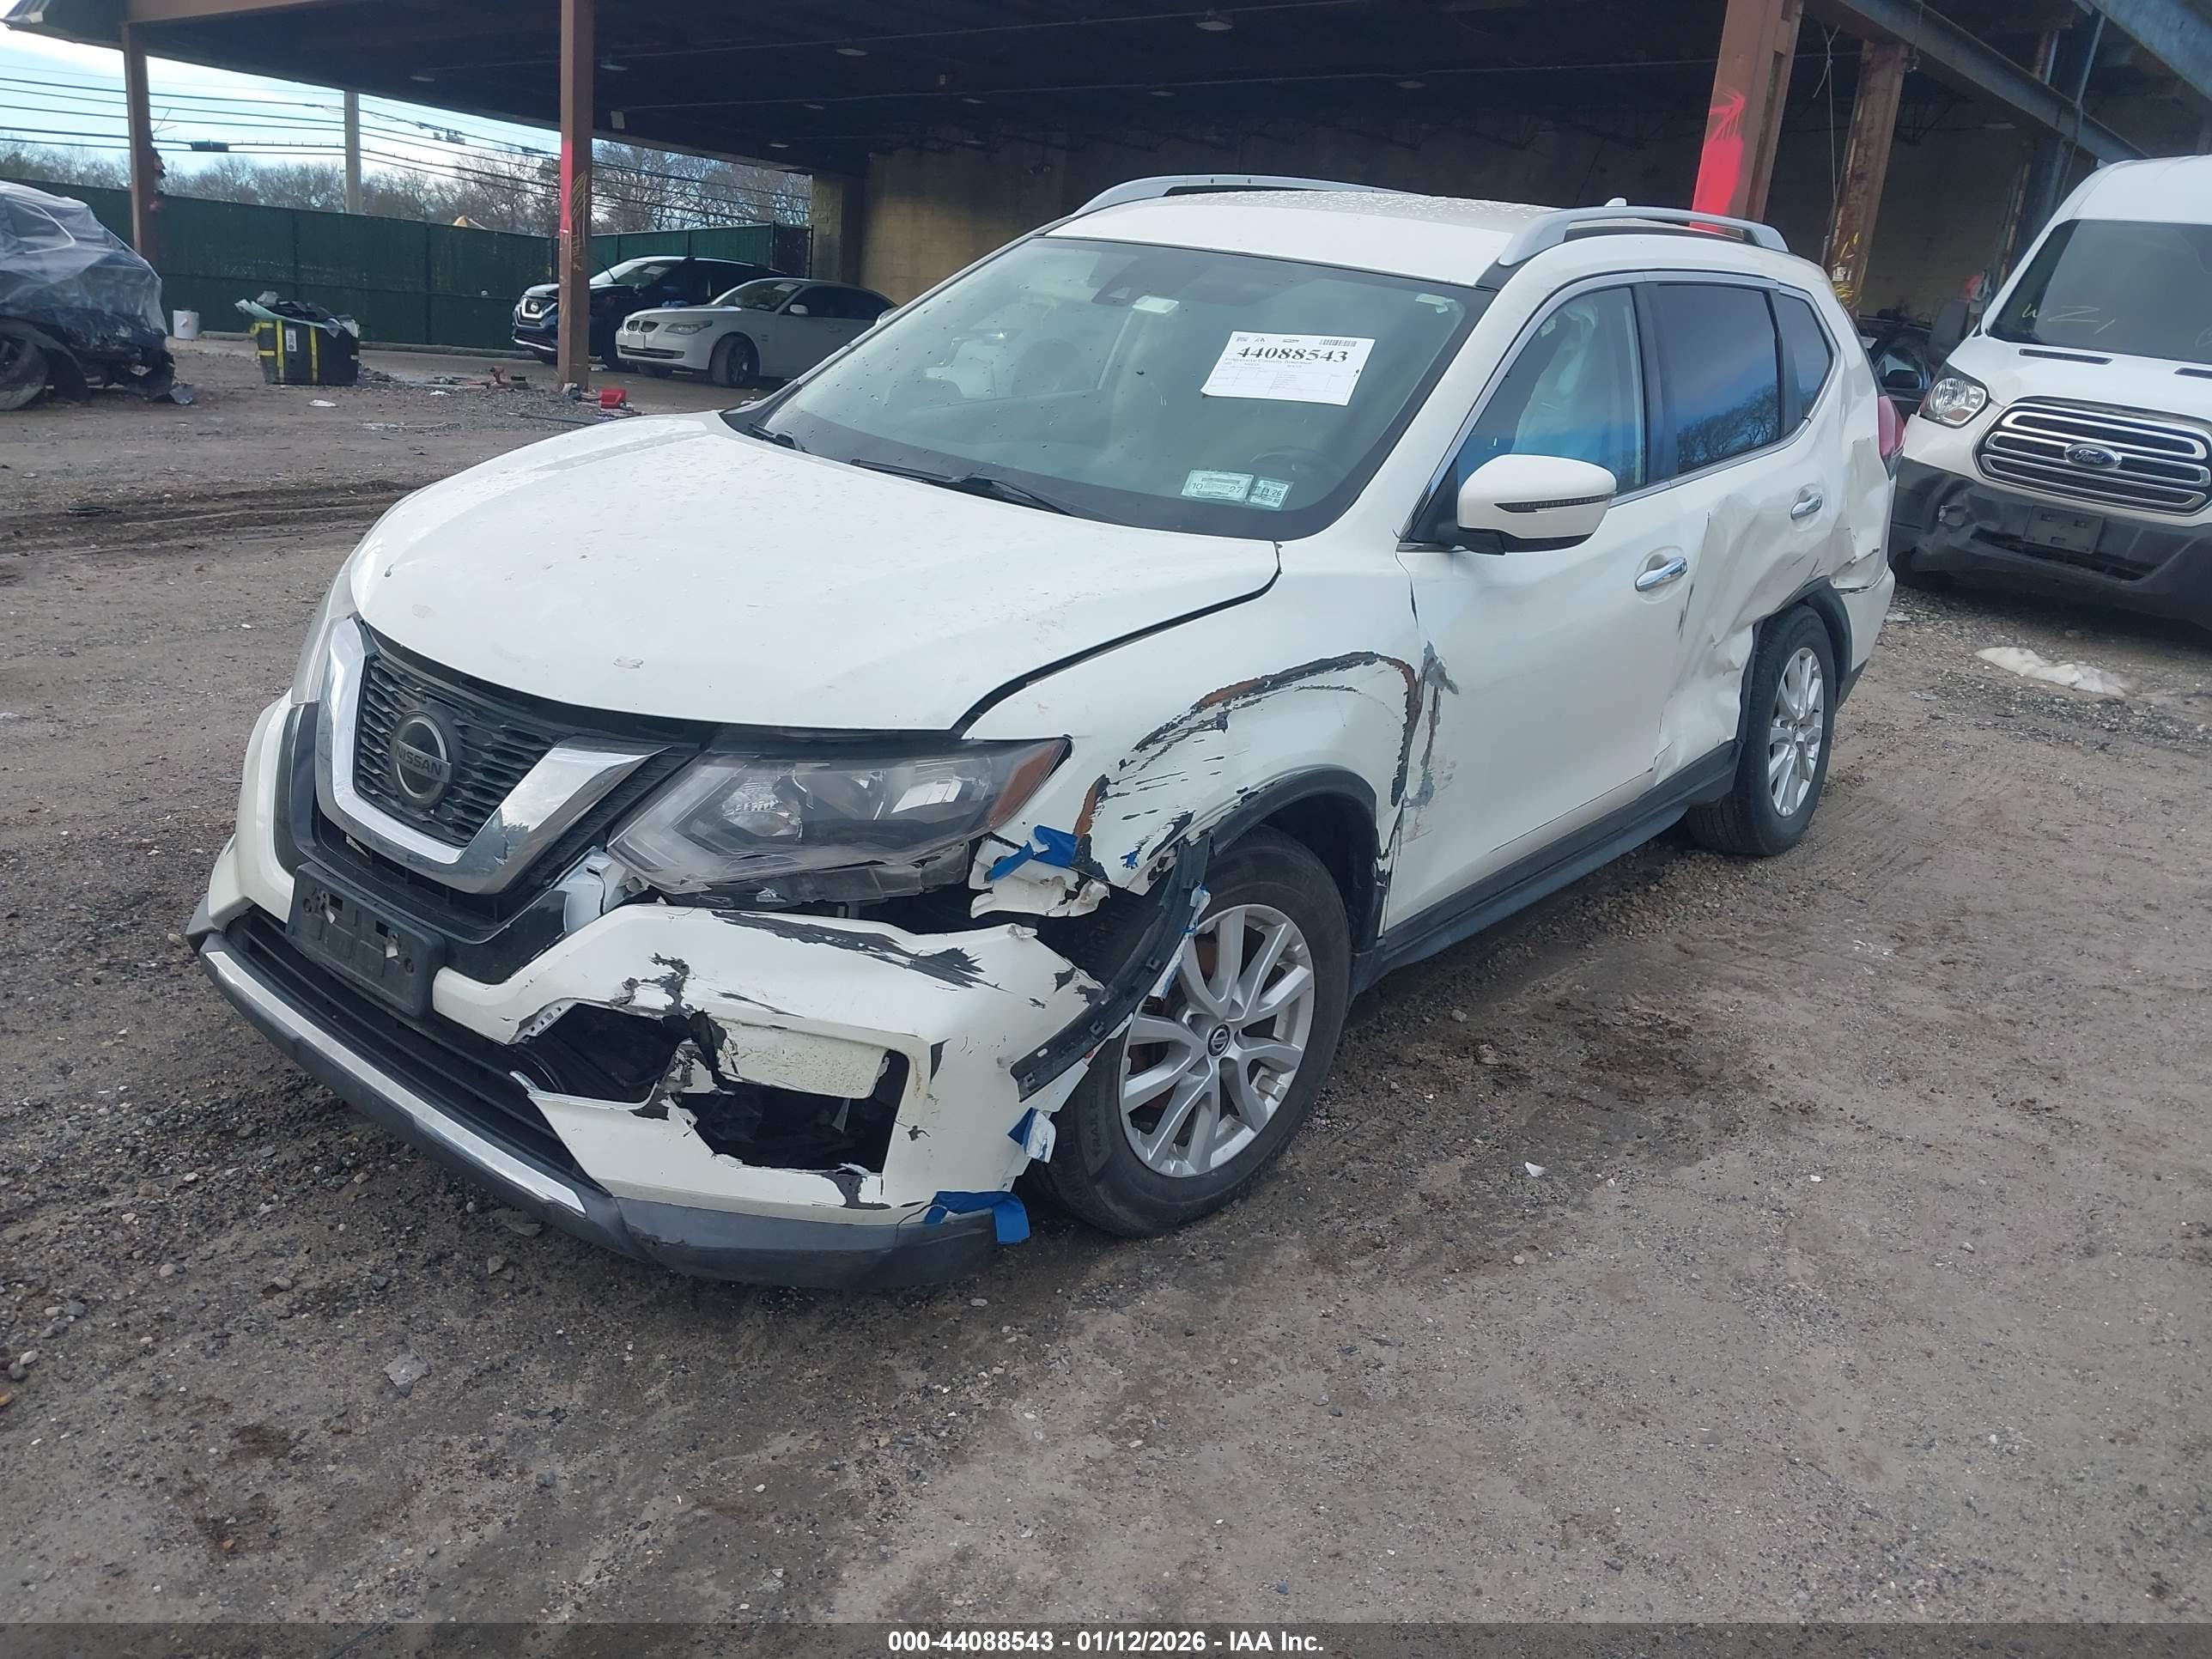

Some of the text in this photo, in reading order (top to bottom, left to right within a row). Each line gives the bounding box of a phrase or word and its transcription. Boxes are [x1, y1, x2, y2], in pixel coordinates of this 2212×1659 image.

[1237, 346, 1349, 363] 44088543
[2075, 449, 2106, 464] Ford
[396, 745, 442, 776] NISSAN
